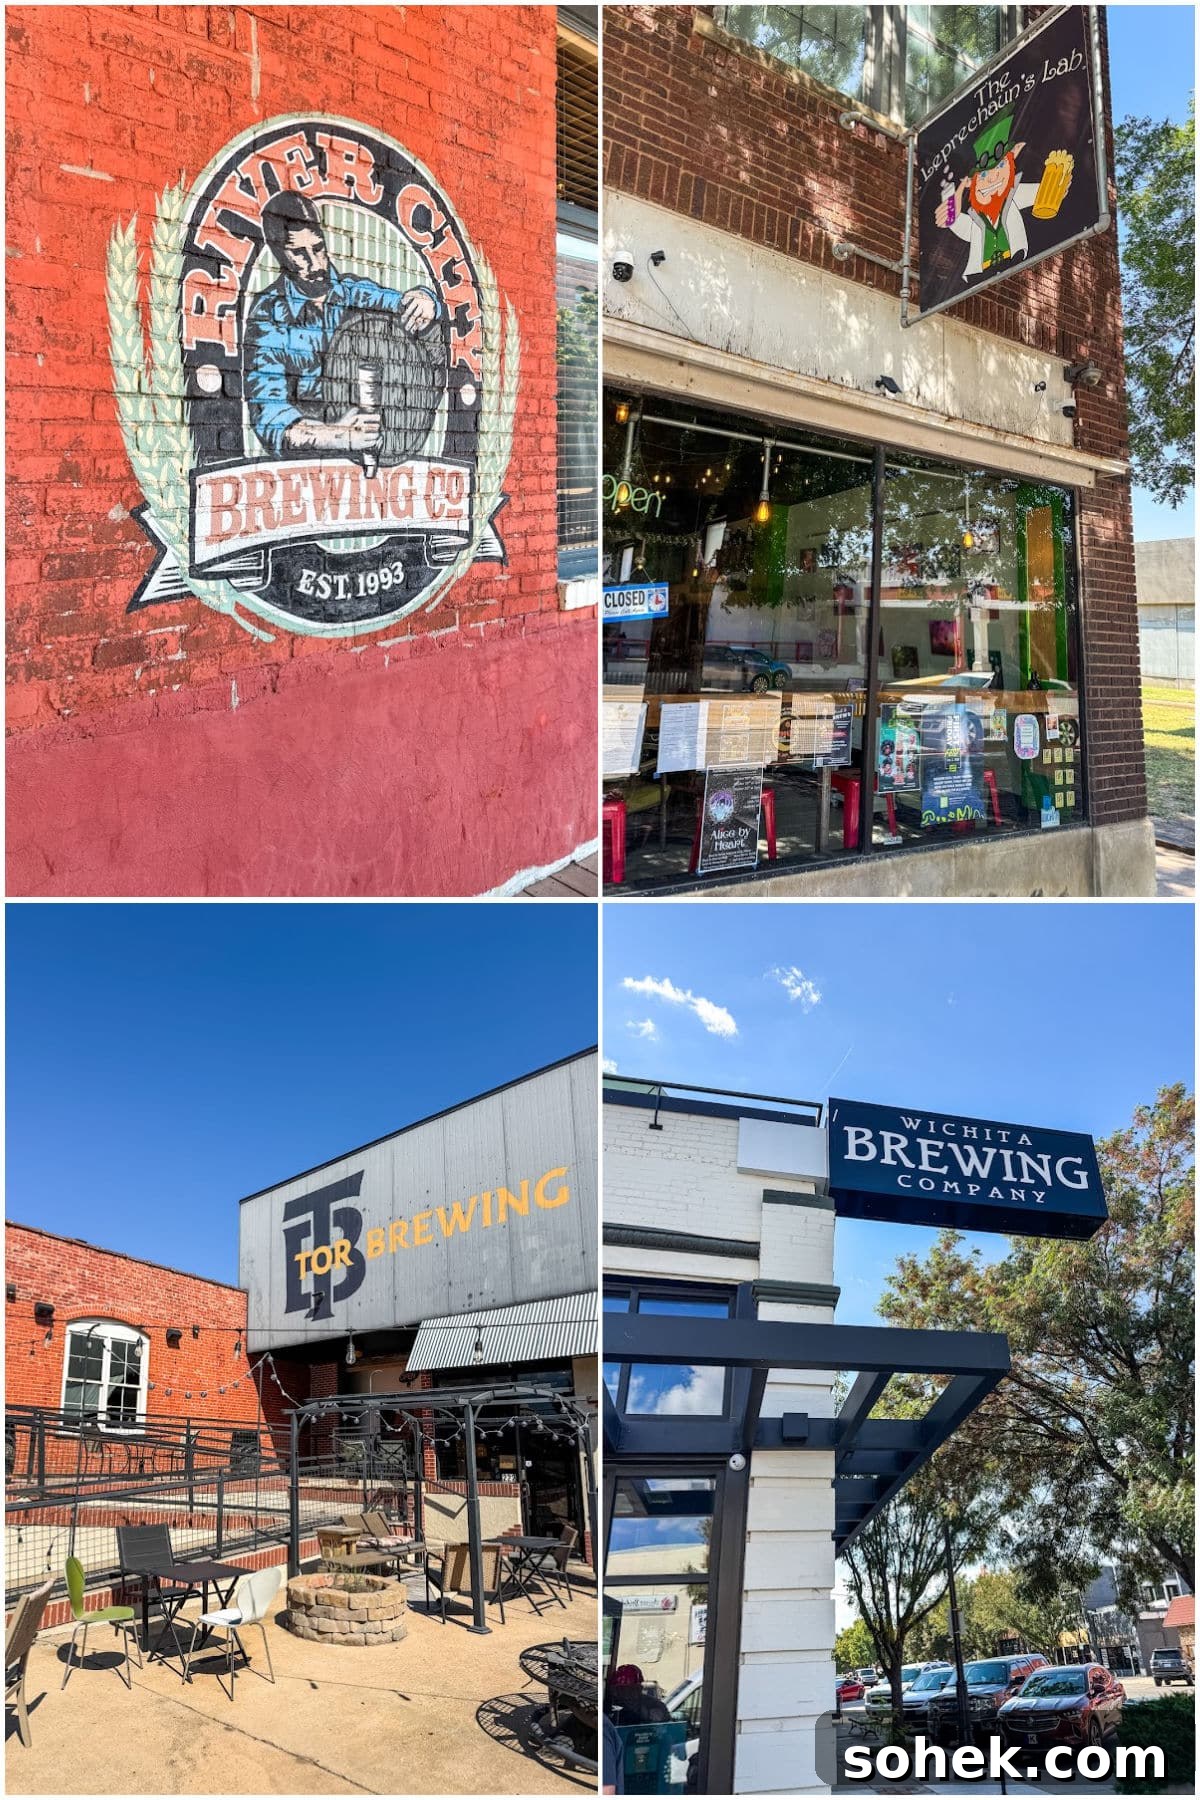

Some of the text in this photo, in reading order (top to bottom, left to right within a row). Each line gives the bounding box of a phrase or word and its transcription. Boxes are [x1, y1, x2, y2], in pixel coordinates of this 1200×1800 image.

[974, 71, 1011, 106] The
[920, 48, 1083, 182] Leprechaun's Lab
[182, 131, 484, 382] RIVER CITY
[204, 463, 417, 546] BREWING
[297, 561, 405, 601] EST. 1993
[604, 590, 646, 609] CLOSED
[714, 838, 746, 852] Heart
[738, 827, 752, 840] by
[900, 1115, 1033, 1146] WICHITA
[842, 1125, 1090, 1190] BREWING
[897, 1174, 1047, 1204] COMPANY
[294, 1166, 570, 1281] TOR BREWING
